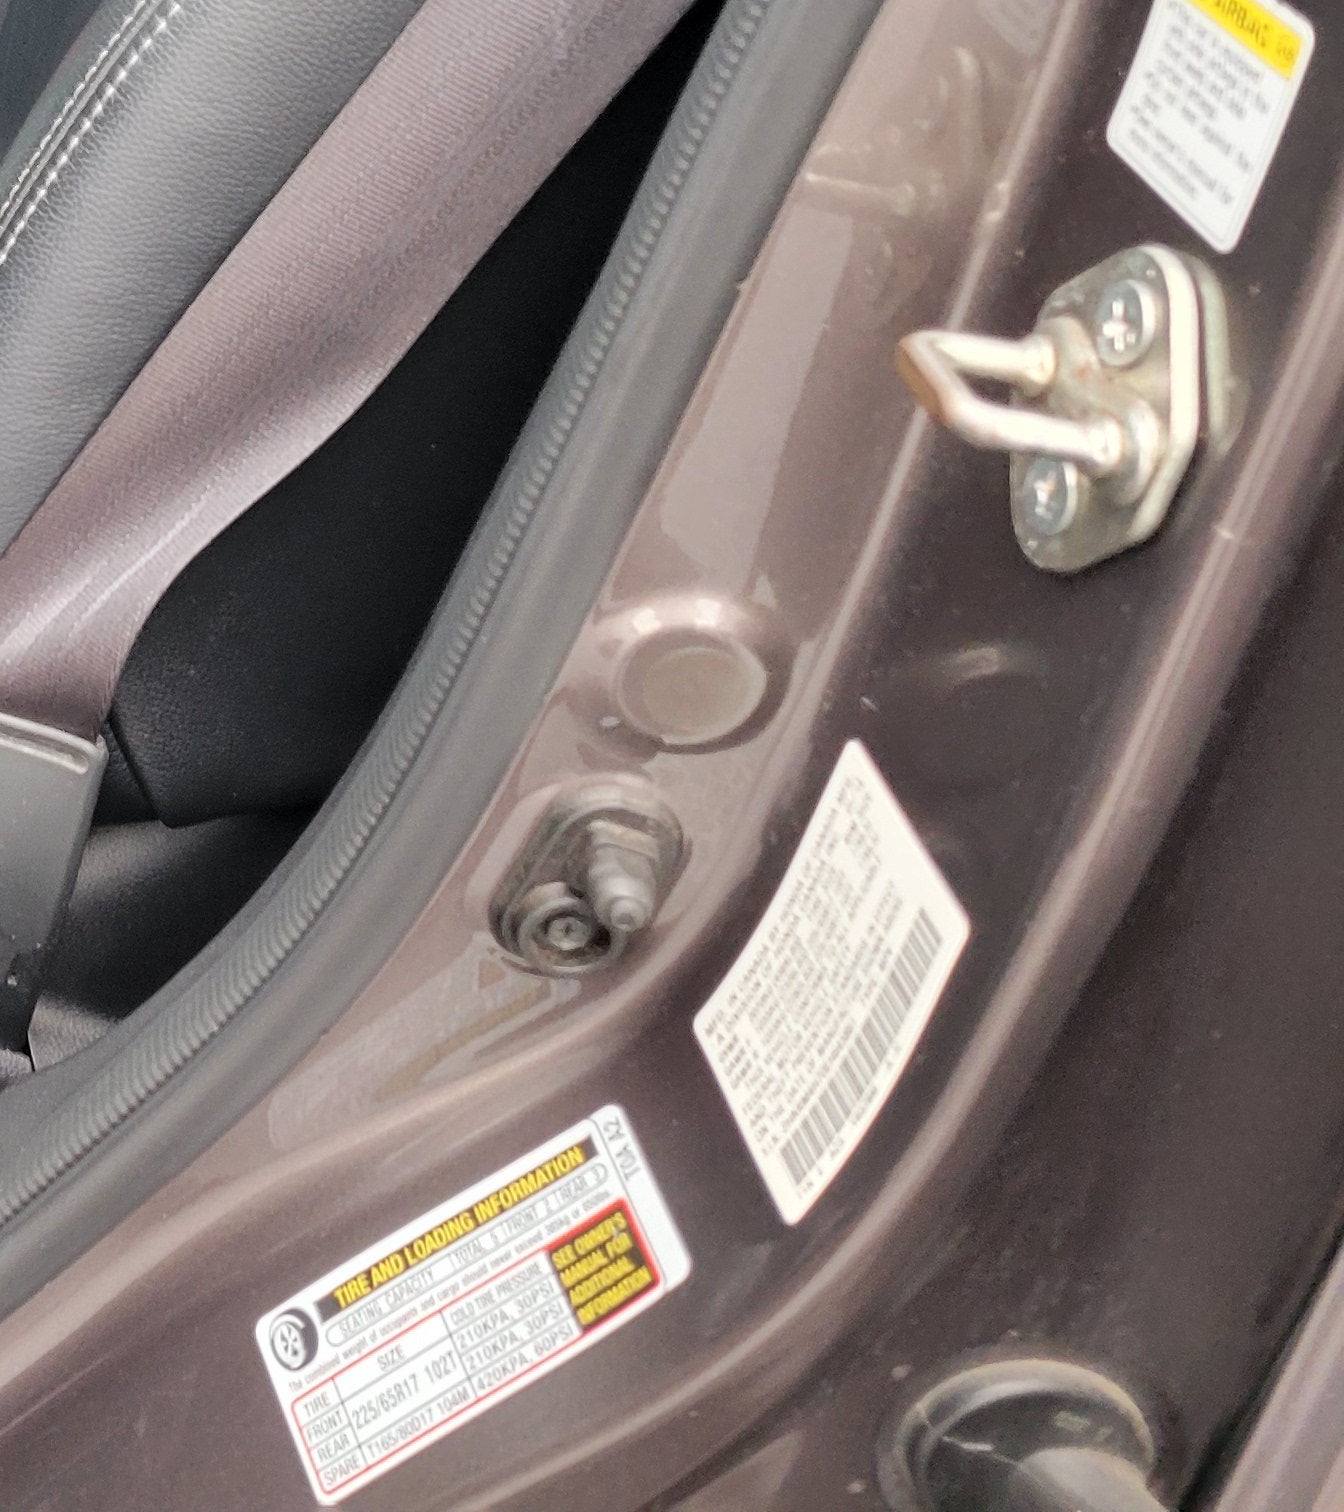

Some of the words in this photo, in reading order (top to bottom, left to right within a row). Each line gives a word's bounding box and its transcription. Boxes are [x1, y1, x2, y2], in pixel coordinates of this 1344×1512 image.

[335, 1274, 369, 1308] TIRE
[369, 1251, 406, 1286] AND
[405, 1209, 473, 1266] LOADING
[473, 1142, 583, 1225] INFORMATION
[341, 1303, 381, 1336] SEATING
[386, 1270, 433, 1306] CAPACITY
[455, 1240, 482, 1265] TOTAL
[559, 1174, 588, 1200] REAR
[552, 1243, 575, 1268] SEE
[560, 1248, 607, 1287] MANUAL
[606, 1231, 631, 1257] FOR
[451, 1302, 475, 1325] COLD
[475, 1290, 495, 1310] TIRE
[495, 1261, 541, 1299] PRESSURE
[515, 1279, 553, 1313] 30PSI
[568, 1255, 633, 1306] ADDITIONAL
[576, 1266, 651, 1325] INFORMATION
[524, 1300, 563, 1334] 30PSI
[533, 1320, 573, 1356] 60PSI
[378, 1344, 403, 1370] SIZE
[304, 1392, 329, 1417] TIRE
[351, 1372, 422, 1431] 225/65R17
[424, 1349, 459, 1384] 102T
[306, 1409, 343, 1442] FRONT
[367, 1405, 435, 1459] T165/80D17
[437, 1384, 469, 1415] 104M
[317, 1433, 349, 1462] REAR
[324, 1454, 359, 1486] SPARE
